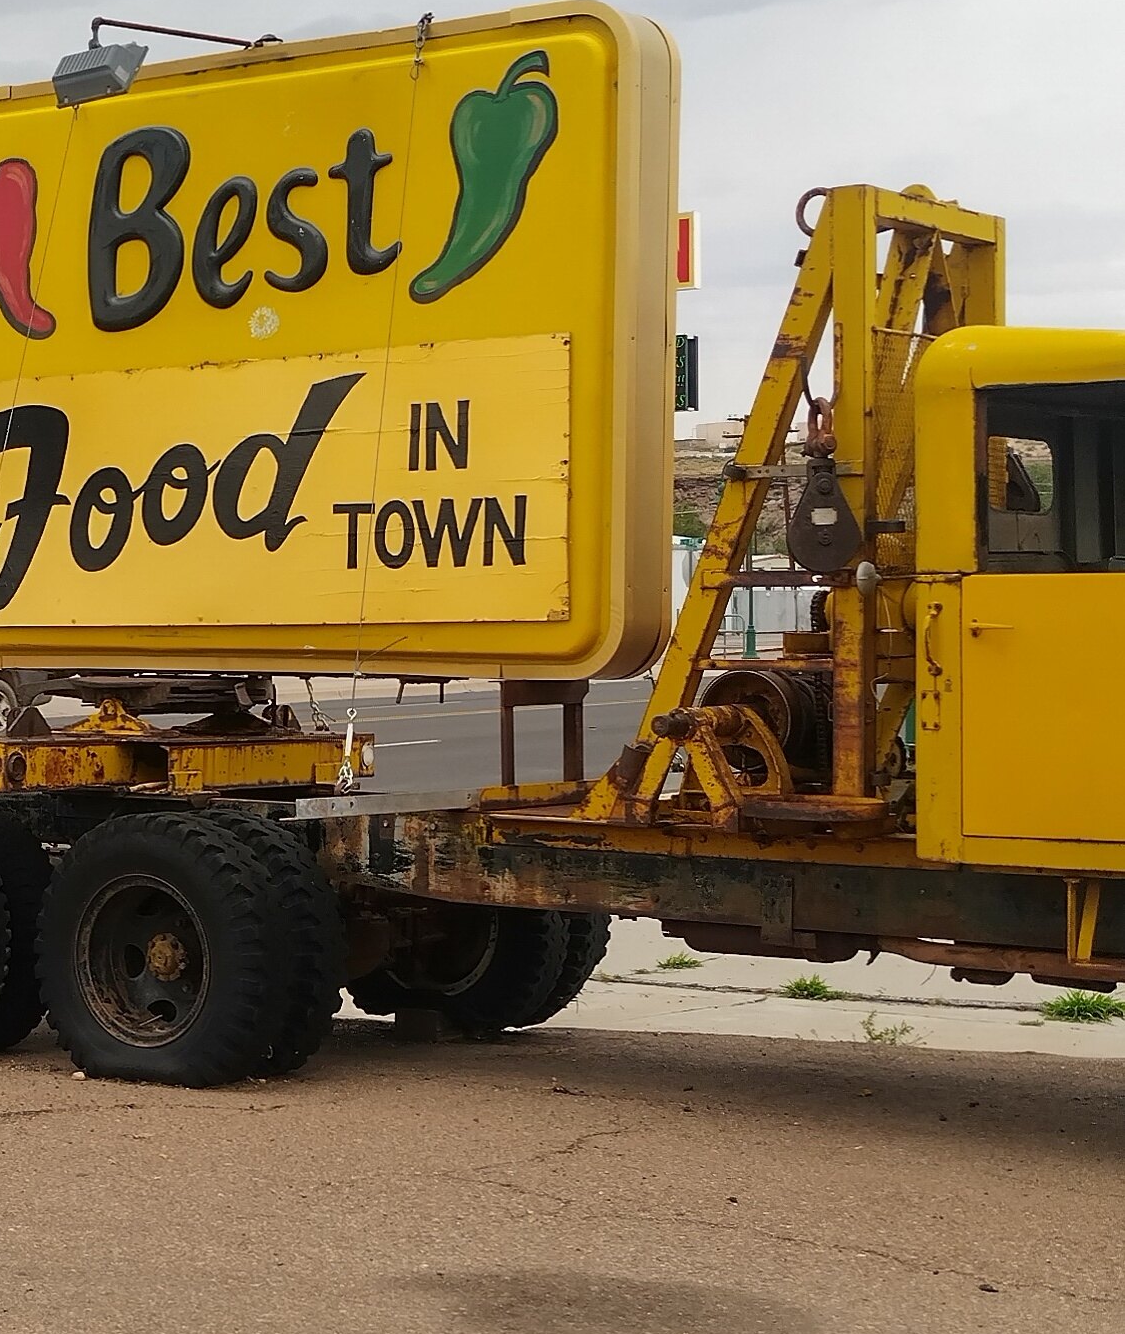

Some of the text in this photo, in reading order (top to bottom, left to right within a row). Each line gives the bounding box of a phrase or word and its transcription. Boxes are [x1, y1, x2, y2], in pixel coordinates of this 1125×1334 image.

[87, 126, 402, 332] Best
[408, 399, 470, 472] IN
[333, 494, 528, 571] TOWN
